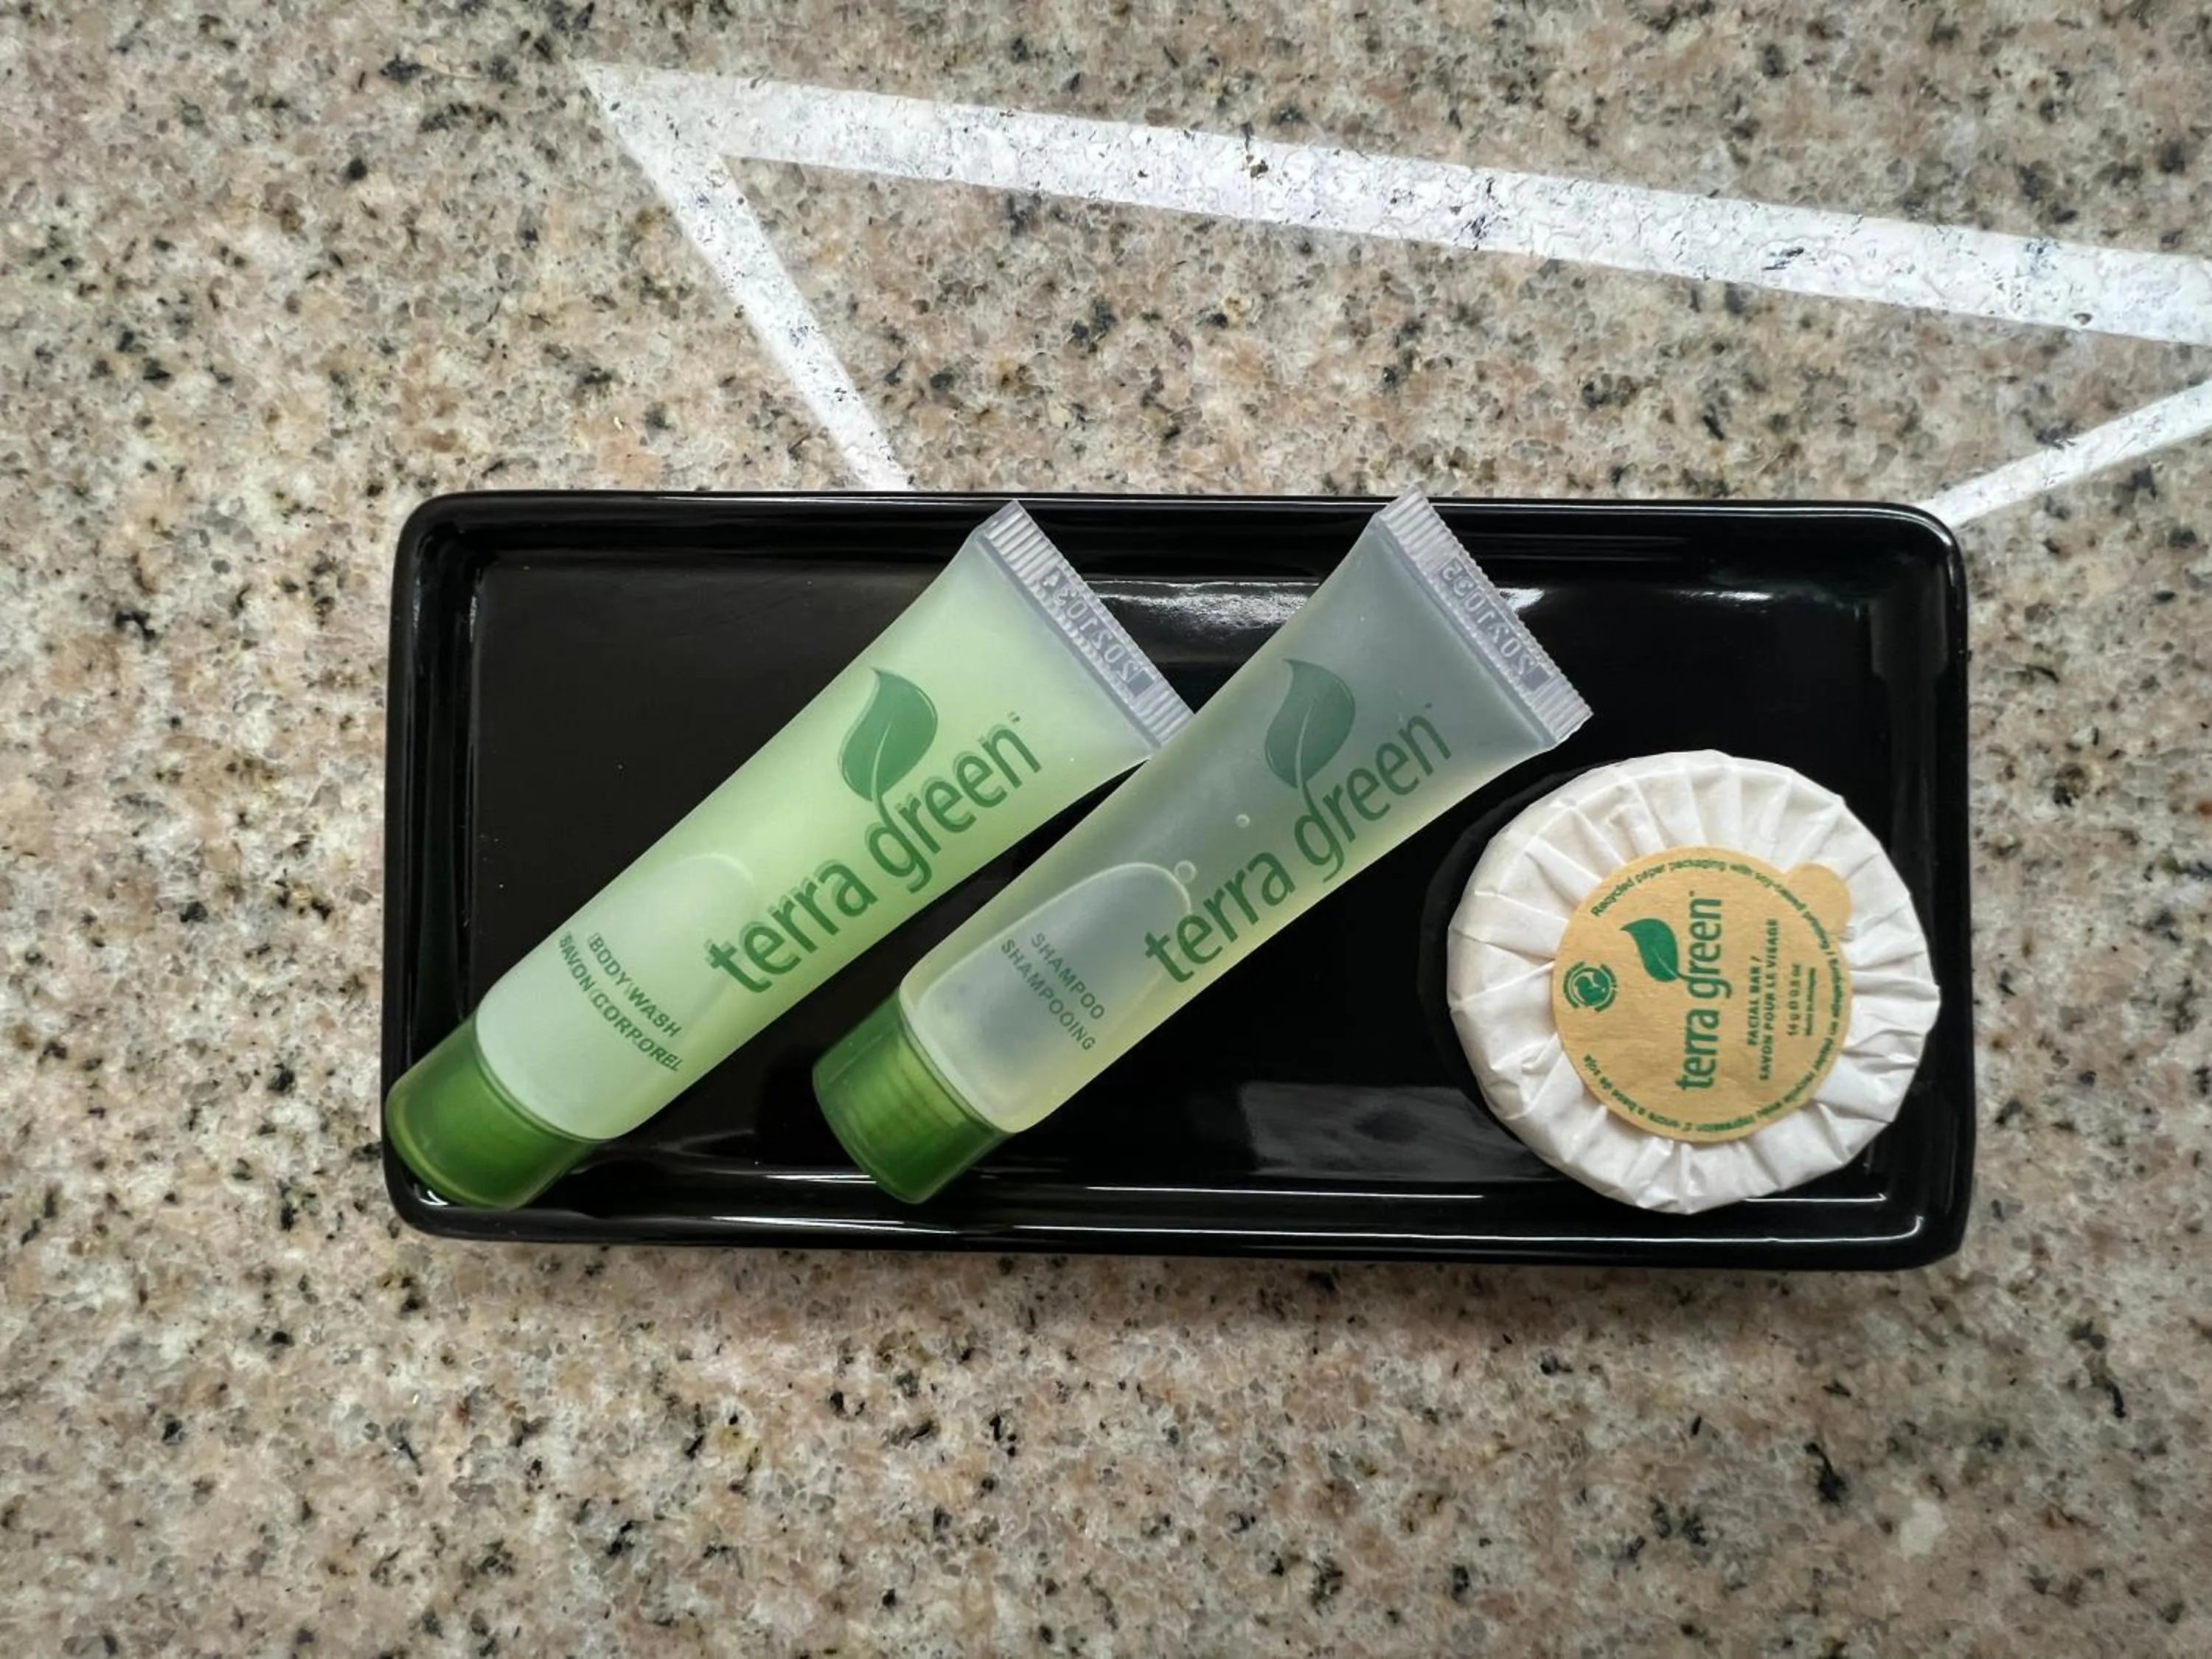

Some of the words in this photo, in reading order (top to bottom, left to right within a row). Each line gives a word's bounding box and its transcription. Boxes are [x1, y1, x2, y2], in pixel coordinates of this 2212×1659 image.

[705, 863, 878, 992] terra
[866, 726, 1042, 894] green
[1145, 852, 1295, 983] terra
[1294, 714, 1451, 883] green
[1590, 878, 1635, 917] Recycled
[1635, 864, 1665, 883] paper
[1032, 932, 1105, 1019] SHAMPOO
[1687, 897, 1732, 998] green
[1749, 967, 1760, 993] BAR
[1766, 919, 1778, 968] VISAGE
[1766, 973, 1775, 989] LE
[559, 933, 597, 992] SAVON
[591, 992, 684, 1071] CORPOREL
[589, 935, 632, 986] BODY
[628, 987, 682, 1037] WASH
[1001, 939, 1096, 1050] SHAMPOOING
[1747, 1000, 1759, 1046] FACIAL
[1763, 993, 1775, 1030] POUR
[1675, 1009, 1719, 1091] terra
[1759, 1035, 1773, 1079] SAVON
